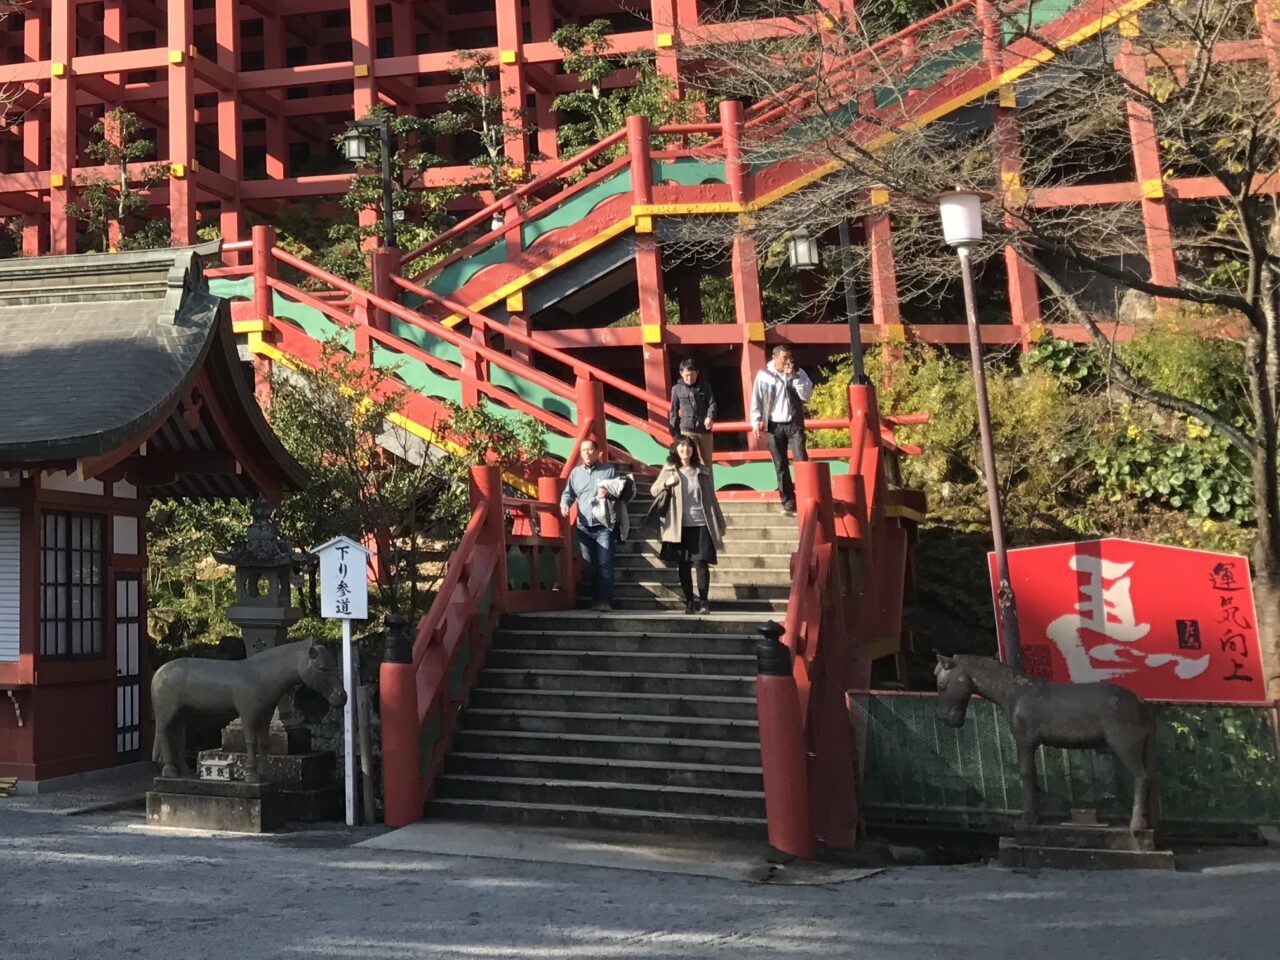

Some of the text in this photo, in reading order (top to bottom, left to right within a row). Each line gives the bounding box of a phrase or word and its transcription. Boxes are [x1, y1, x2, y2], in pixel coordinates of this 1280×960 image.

[335, 545, 352, 615] 下り参道
[1209, 562, 1253, 682] 運気向上
